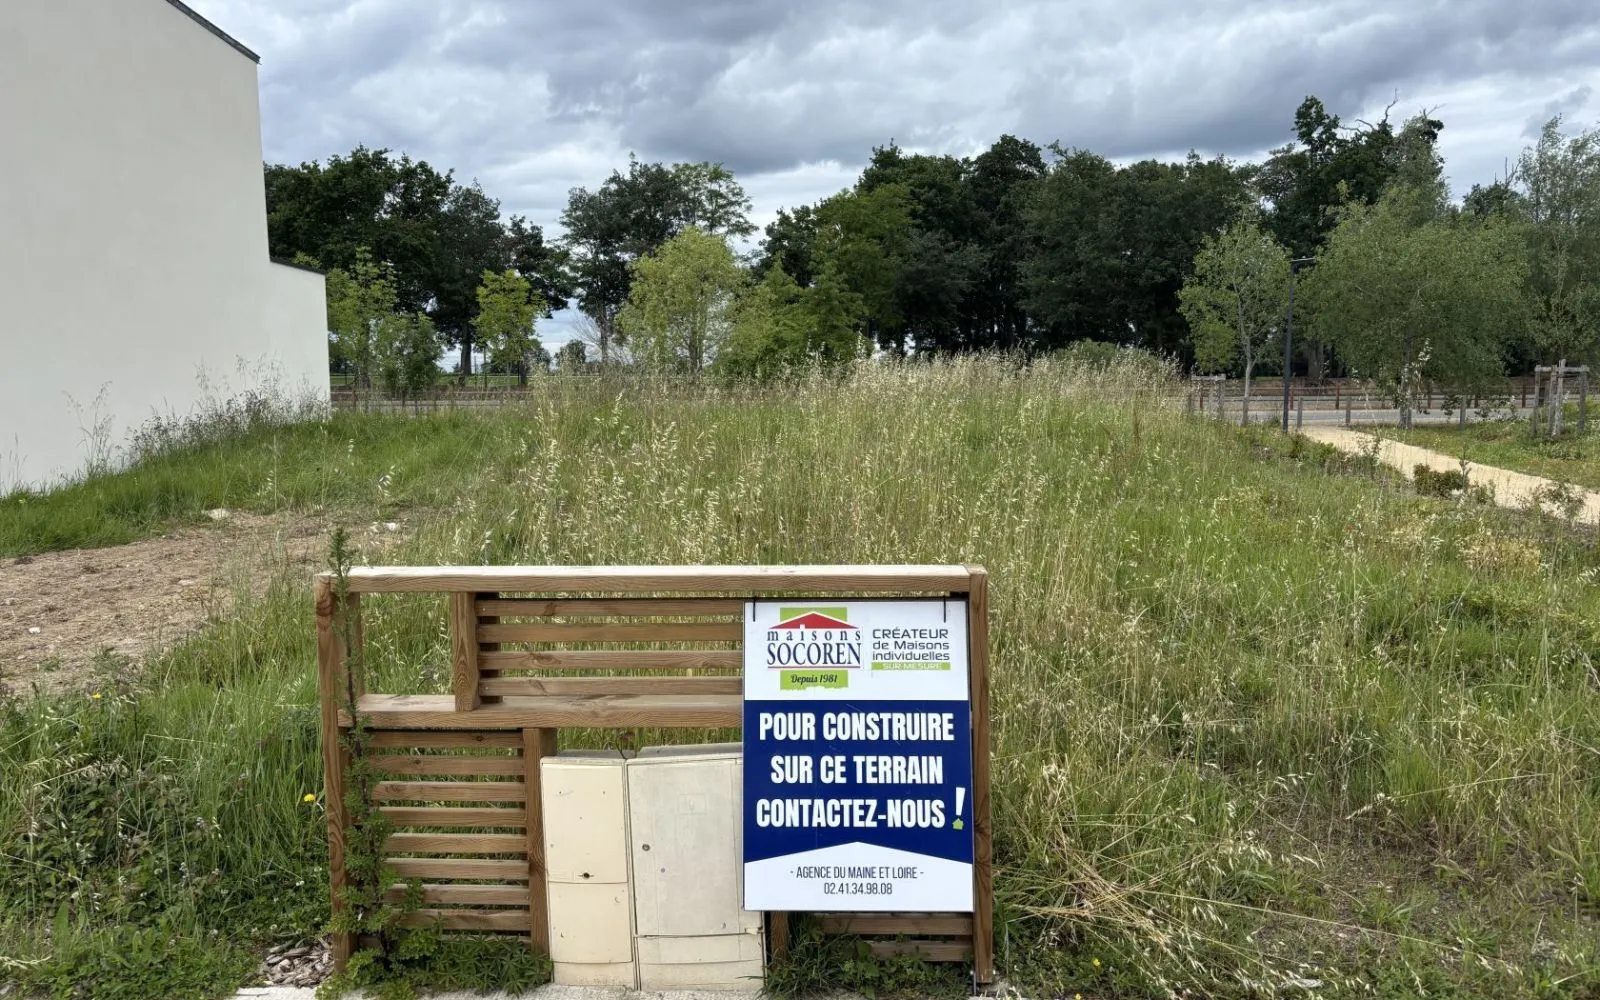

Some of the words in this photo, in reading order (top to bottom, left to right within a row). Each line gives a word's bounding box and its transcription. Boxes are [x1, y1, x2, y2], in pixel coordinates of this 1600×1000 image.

[766, 630, 861, 642] maisons
[872, 627, 949, 639] CRÉATEUR
[872, 640, 890, 650] de
[893, 640, 950, 650] Maisons
[766, 642, 862, 666] SOCOREN
[872, 651, 950, 661] individuelles
[791, 674, 818, 686] Depuis
[819, 674, 838, 683] 1981
[759, 712, 815, 741] POUR
[822, 712, 955, 741] CONSTRUIRE
[770, 755, 813, 784] SUR
[820, 755, 846, 784] CE
[853, 755, 943, 784] TERRAIN
[756, 798, 946, 828] CONTACTEZ-NOUS
[952, 786, 966, 830] !
[796, 866, 832, 879] AGENCE
[833, 866, 846, 879] DU
[848, 866, 877, 879] MAINE
[879, 866, 890, 879] ET
[892, 866, 918, 879] LOIRE
[823, 882, 893, 895] 02.41.34.98.08
